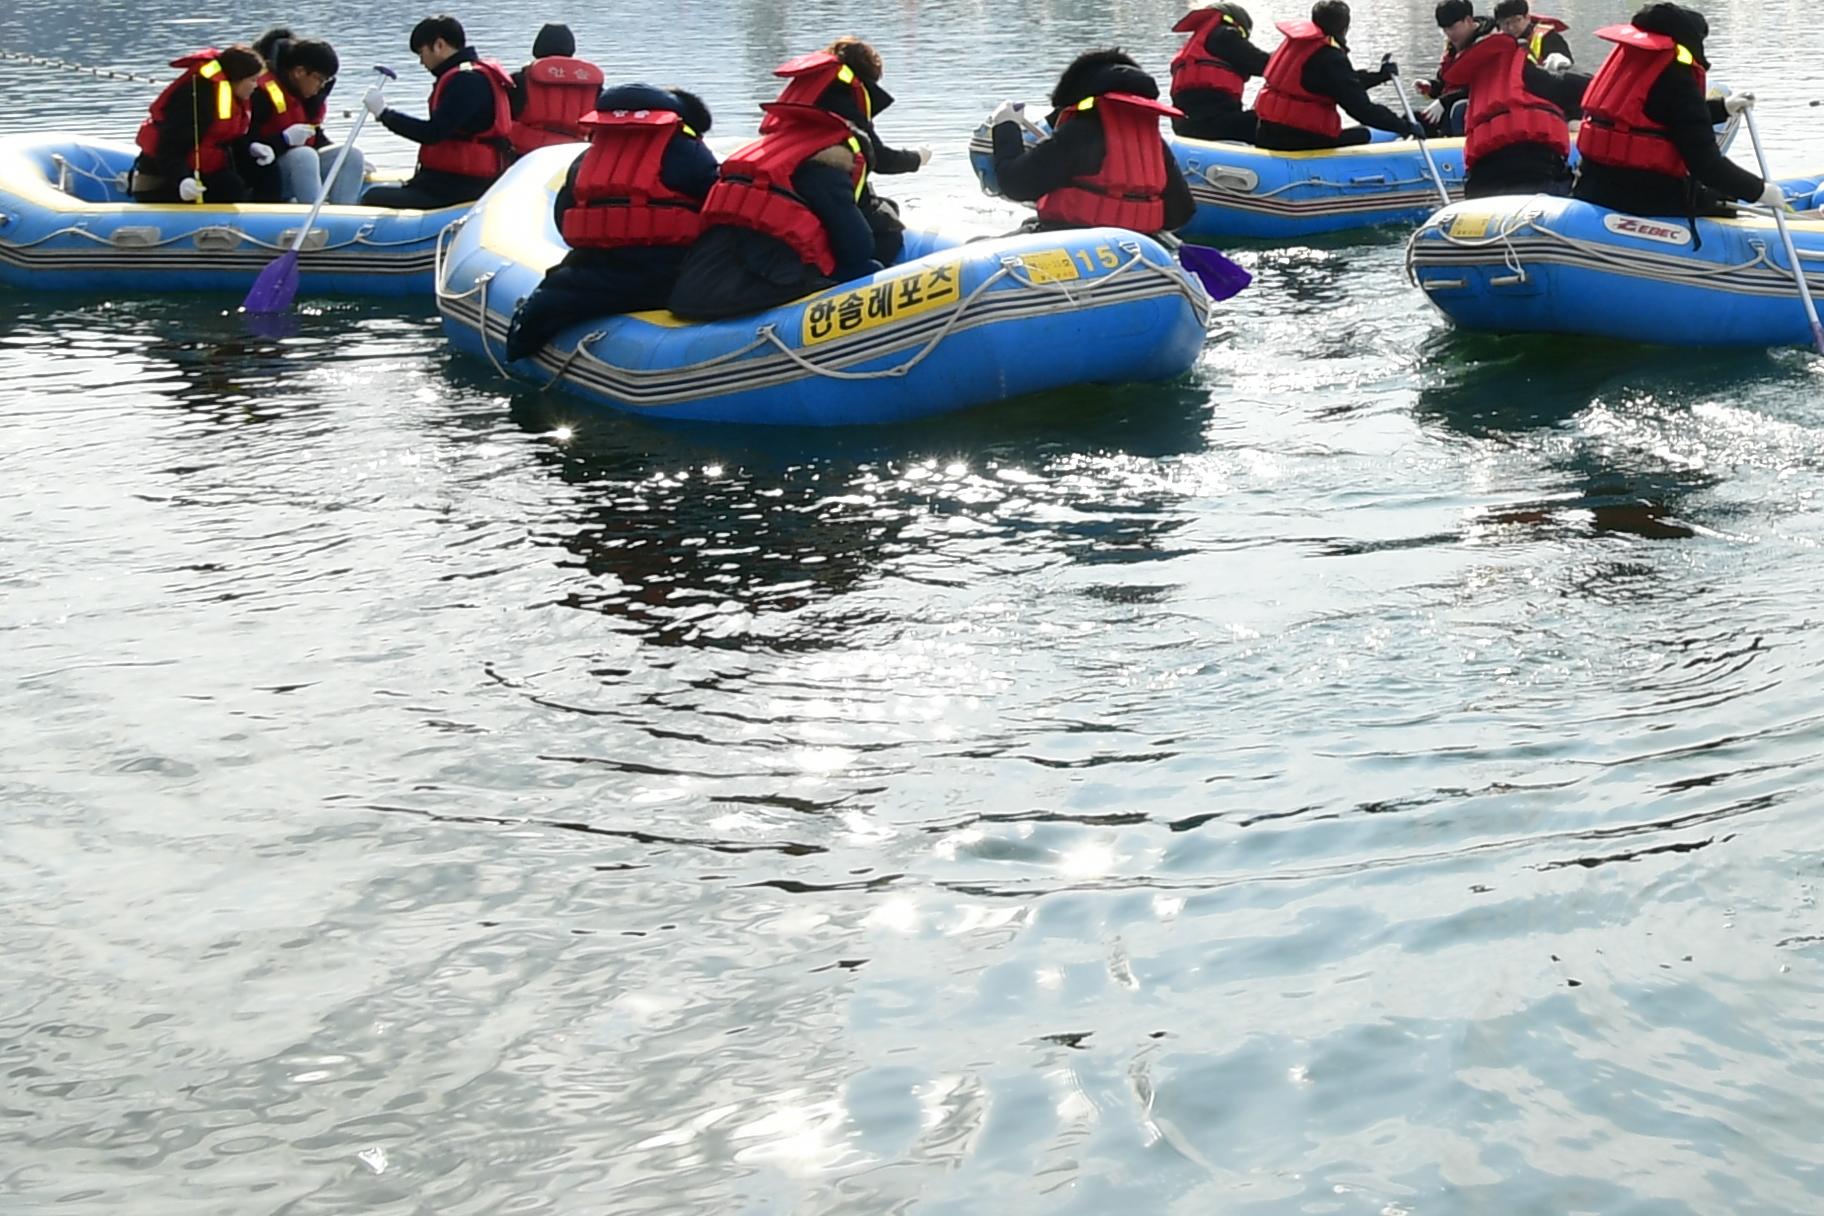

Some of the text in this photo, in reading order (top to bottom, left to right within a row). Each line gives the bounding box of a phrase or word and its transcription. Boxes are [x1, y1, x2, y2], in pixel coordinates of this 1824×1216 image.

[1617, 217, 1681, 240] ZEBEC
[1076, 244, 1119, 272] 15
[809, 264, 954, 339] 한솔레포츠
